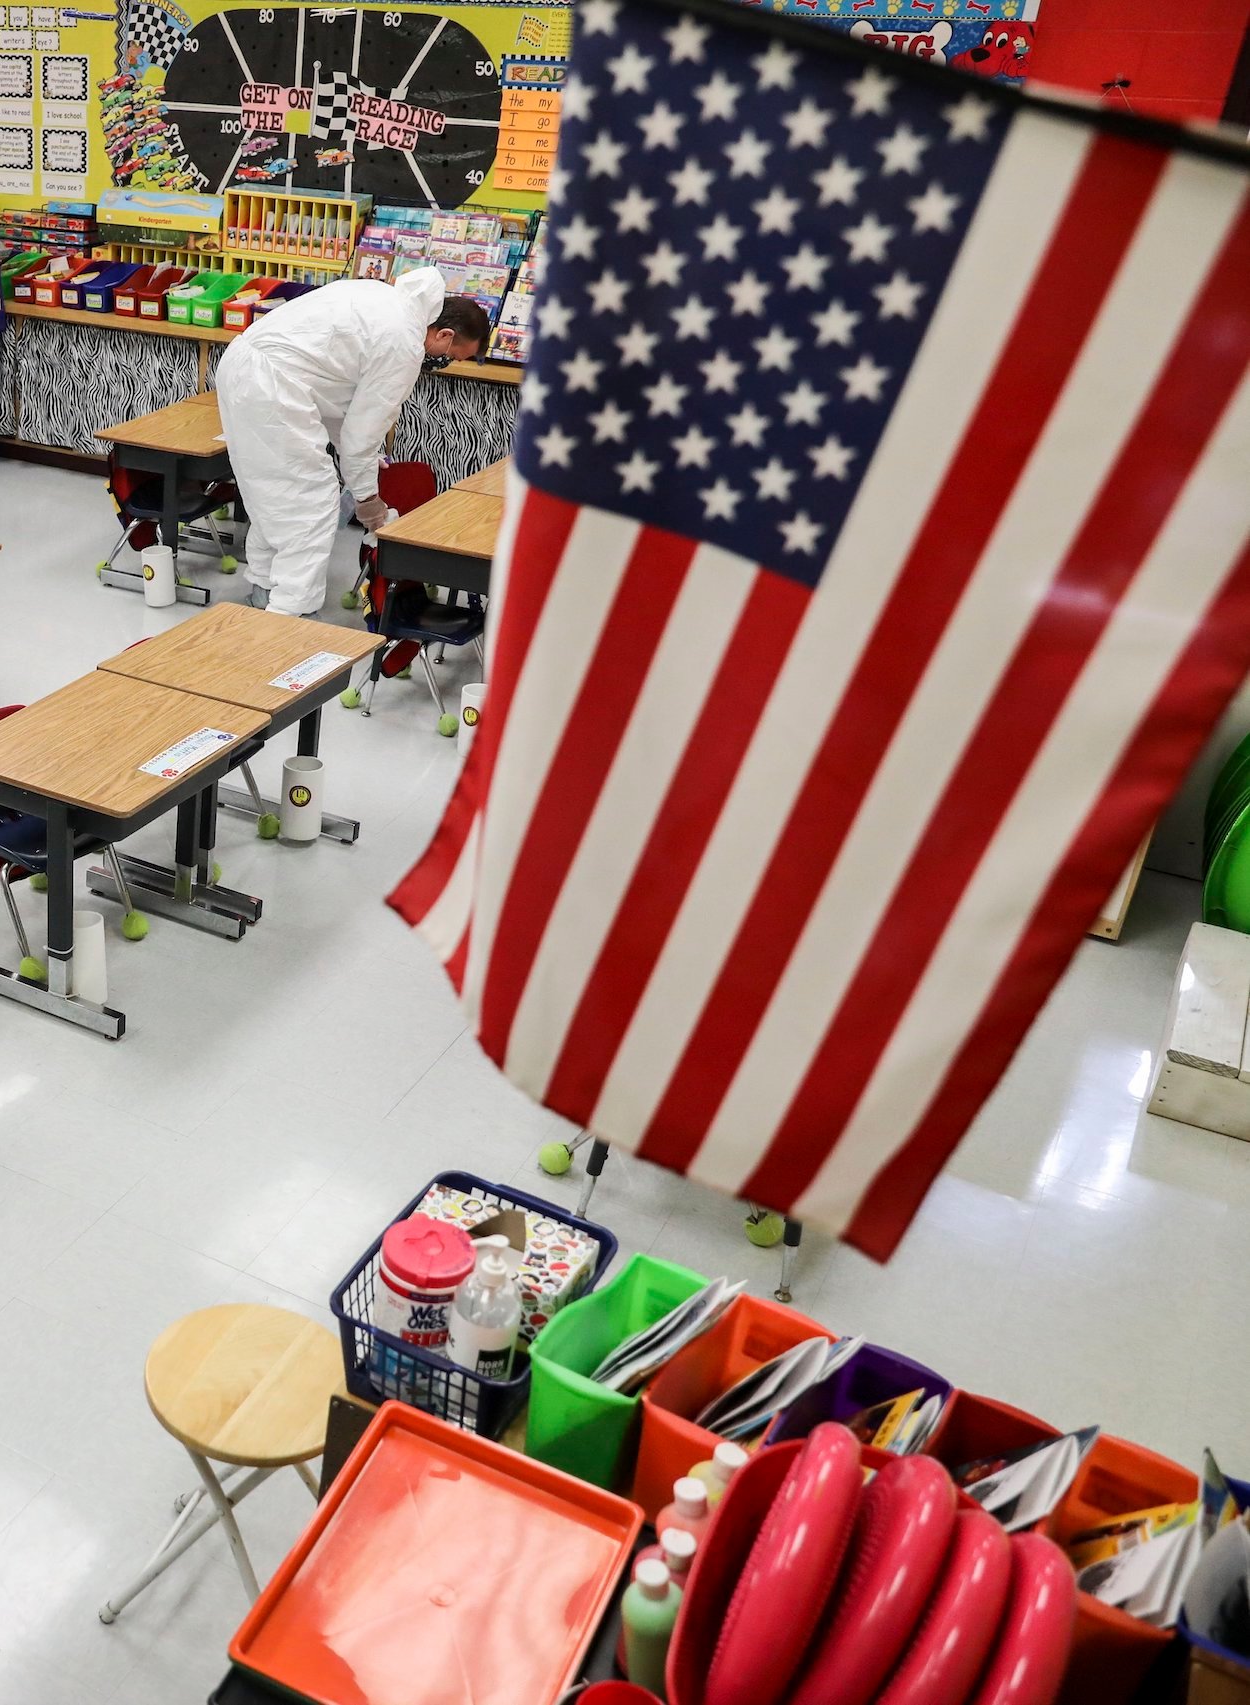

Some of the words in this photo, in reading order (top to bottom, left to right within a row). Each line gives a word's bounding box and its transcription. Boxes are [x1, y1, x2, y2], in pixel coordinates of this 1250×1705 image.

[13, 15, 23, 23] you
[258, 9, 274, 23] 80
[321, 12, 336, 23] 70
[383, 12, 402, 27] 60
[3, 37, 25, 45] writer's
[183, 38, 199, 52] 90
[475, 61, 494, 76] 50
[241, 84, 280, 104] GET
[288, 90, 313, 110] ON
[509, 93, 524, 107] the
[538, 98, 553, 110] my
[1, 108, 10, 116] like
[51, 111, 62, 119] love
[350, 93, 444, 133] READING
[220, 119, 241, 134] 100
[242, 109, 283, 131] THE
[508, 112, 518, 127] I
[537, 118, 551, 129] go
[355, 119, 416, 150] RACE
[507, 137, 515, 146] a
[535, 139, 549, 148] me
[505, 153, 516, 166] to
[531, 154, 549, 167] like
[465, 169, 484, 185] 40
[504, 176, 513, 184] is
[526, 177, 550, 187] come
[138, 216, 172, 225] Kindergarten
[410, 1304, 448, 1320] Wet
[407, 1316, 447, 1330] Ones
[478, 1360, 504, 1370] BORN
